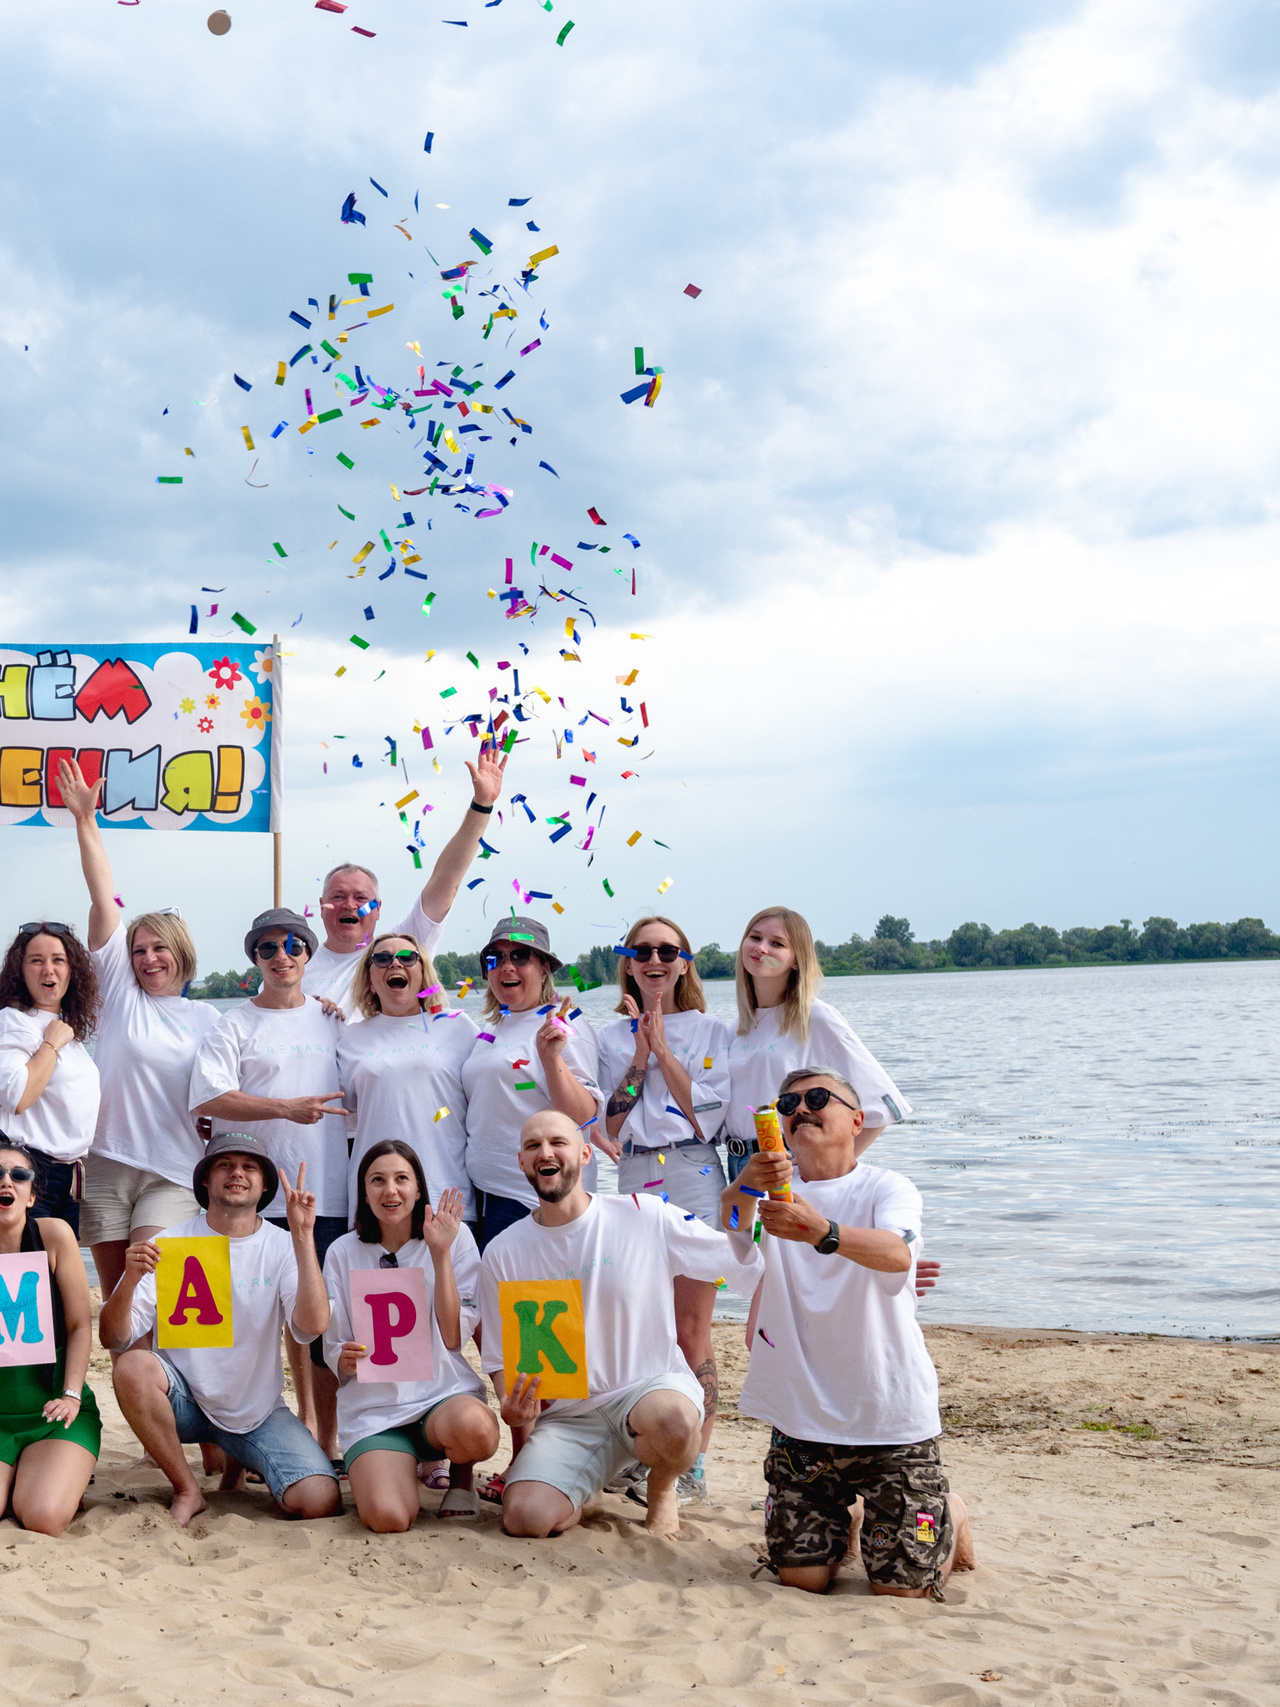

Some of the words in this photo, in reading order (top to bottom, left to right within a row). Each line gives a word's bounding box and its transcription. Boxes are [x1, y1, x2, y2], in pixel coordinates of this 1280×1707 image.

[168, 1256, 224, 1325] А
[539, 1256, 613, 1281] EMARK
[364, 1291, 417, 1366] Р
[513, 1300, 578, 1374] К
